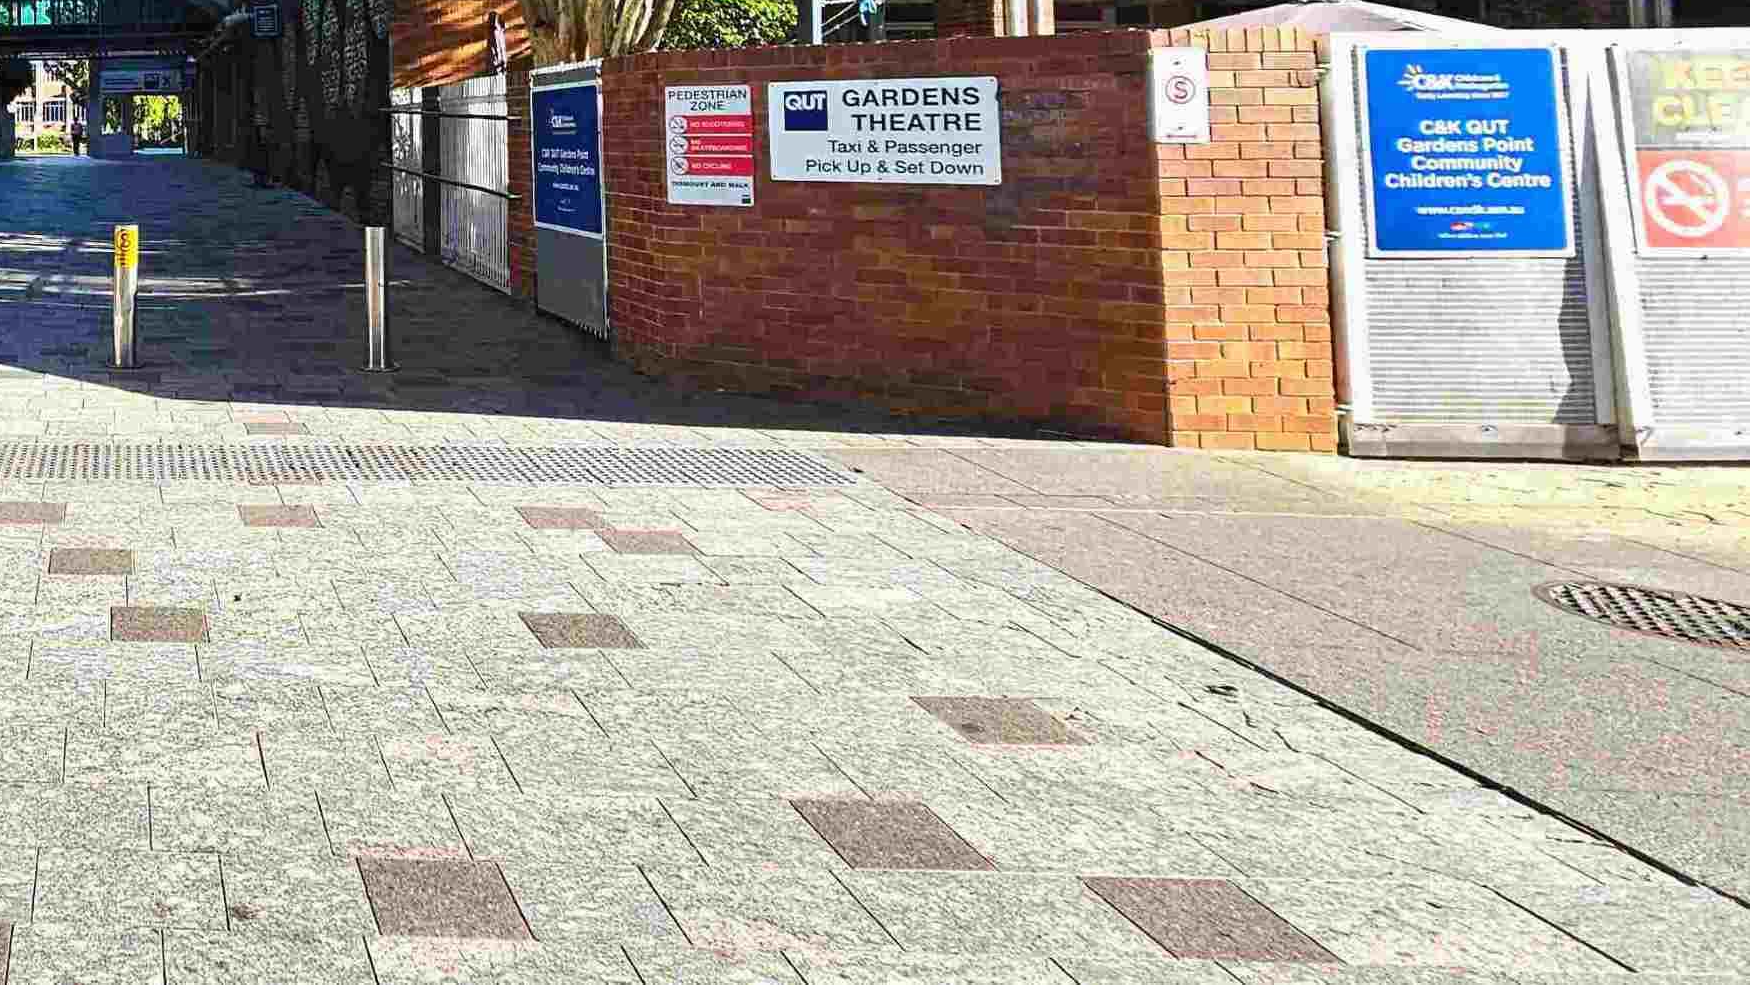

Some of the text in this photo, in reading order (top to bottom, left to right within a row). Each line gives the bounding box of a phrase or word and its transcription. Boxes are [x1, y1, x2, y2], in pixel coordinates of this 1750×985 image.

[668, 89, 747, 101] PEDESTRIAN
[785, 93, 826, 111] QUT
[842, 87, 980, 107] GARDENS
[690, 101, 726, 112] ZONE
[850, 113, 982, 132] THEATRE
[1419, 119, 1509, 135] C&K QUT
[827, 139, 983, 157] Taxi & Passenger
[1397, 136, 1534, 153] Gardens Point
[805, 159, 984, 176] Pick Up & Set Down
[1411, 155, 1523, 172] Community
[1385, 173, 1551, 188] Children's Centre
